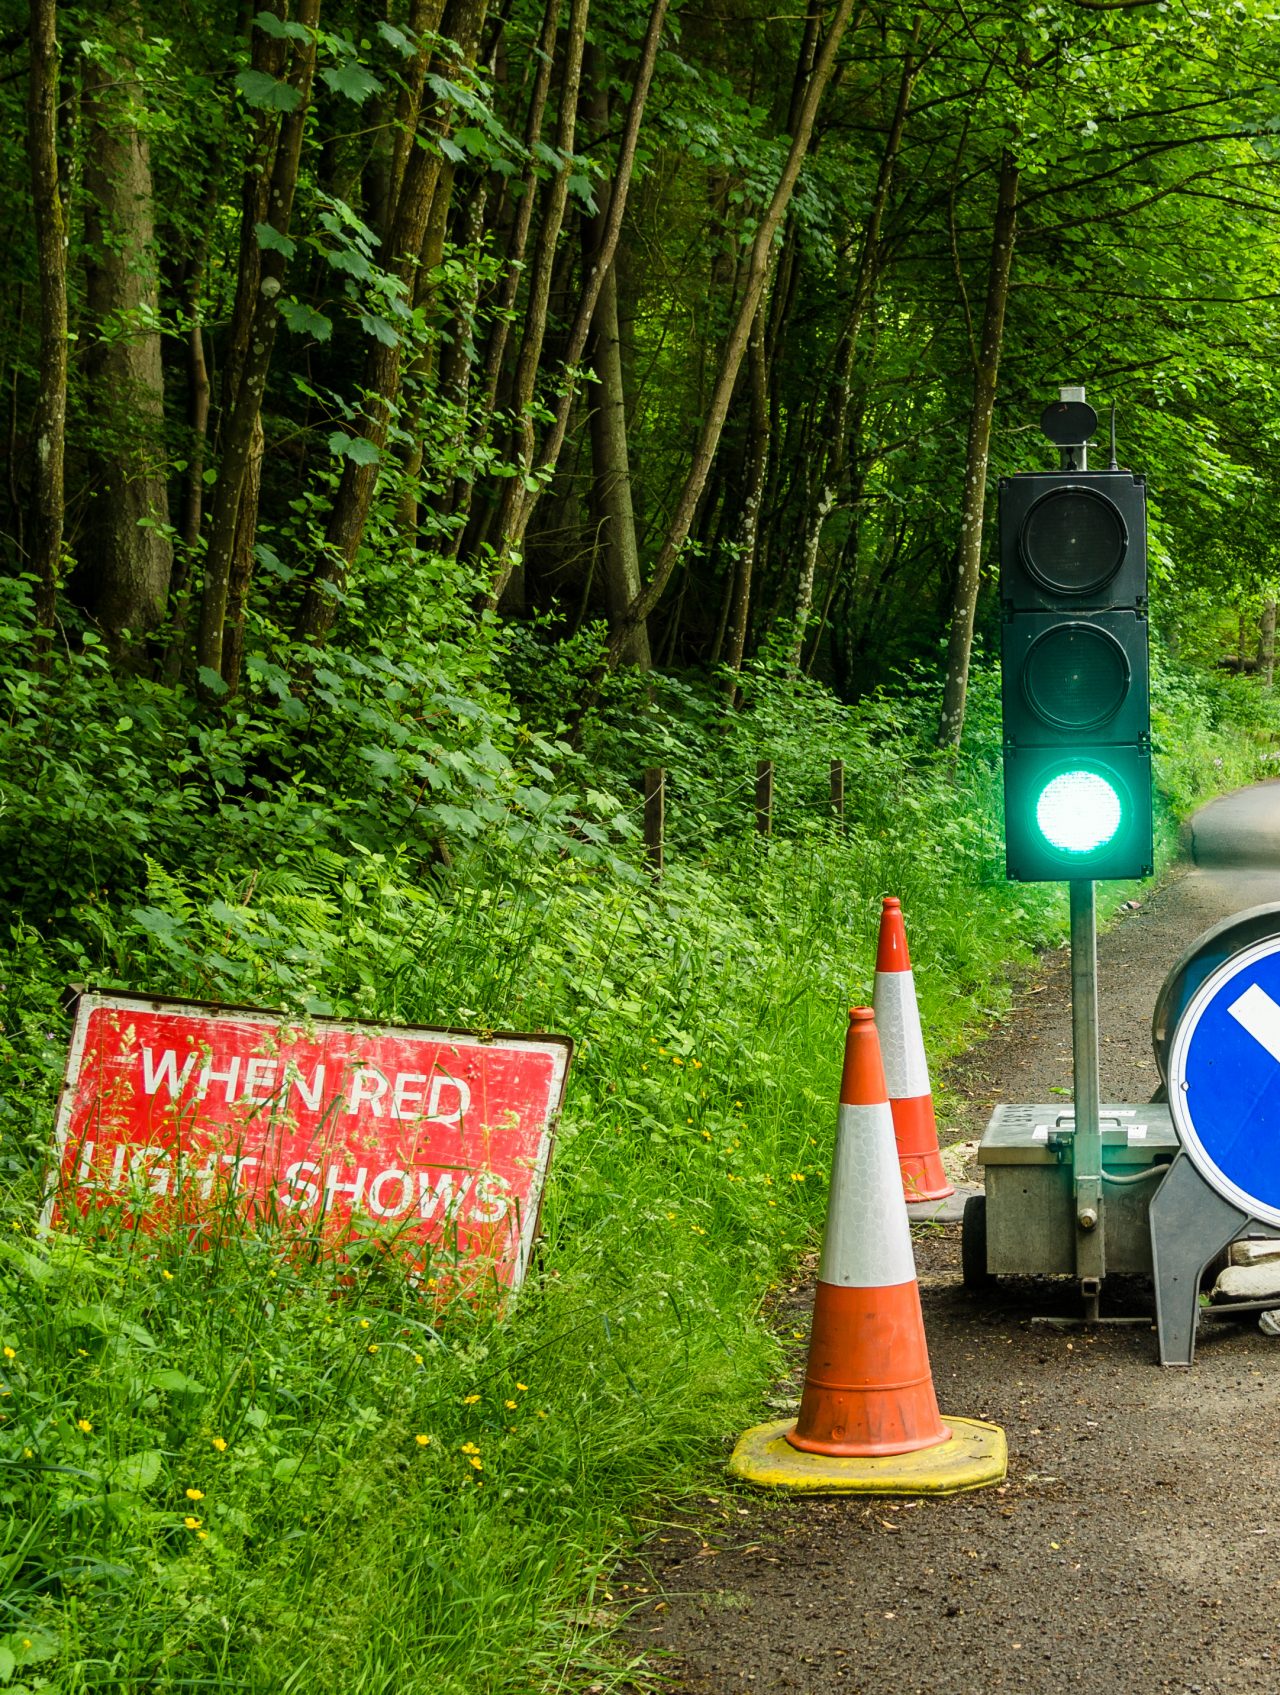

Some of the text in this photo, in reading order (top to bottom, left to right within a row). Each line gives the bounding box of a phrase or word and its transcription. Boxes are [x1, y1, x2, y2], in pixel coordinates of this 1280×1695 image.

[142, 1046, 472, 1125] WHEN RED
[78, 1141, 512, 1222] LIGHT SHOWS
